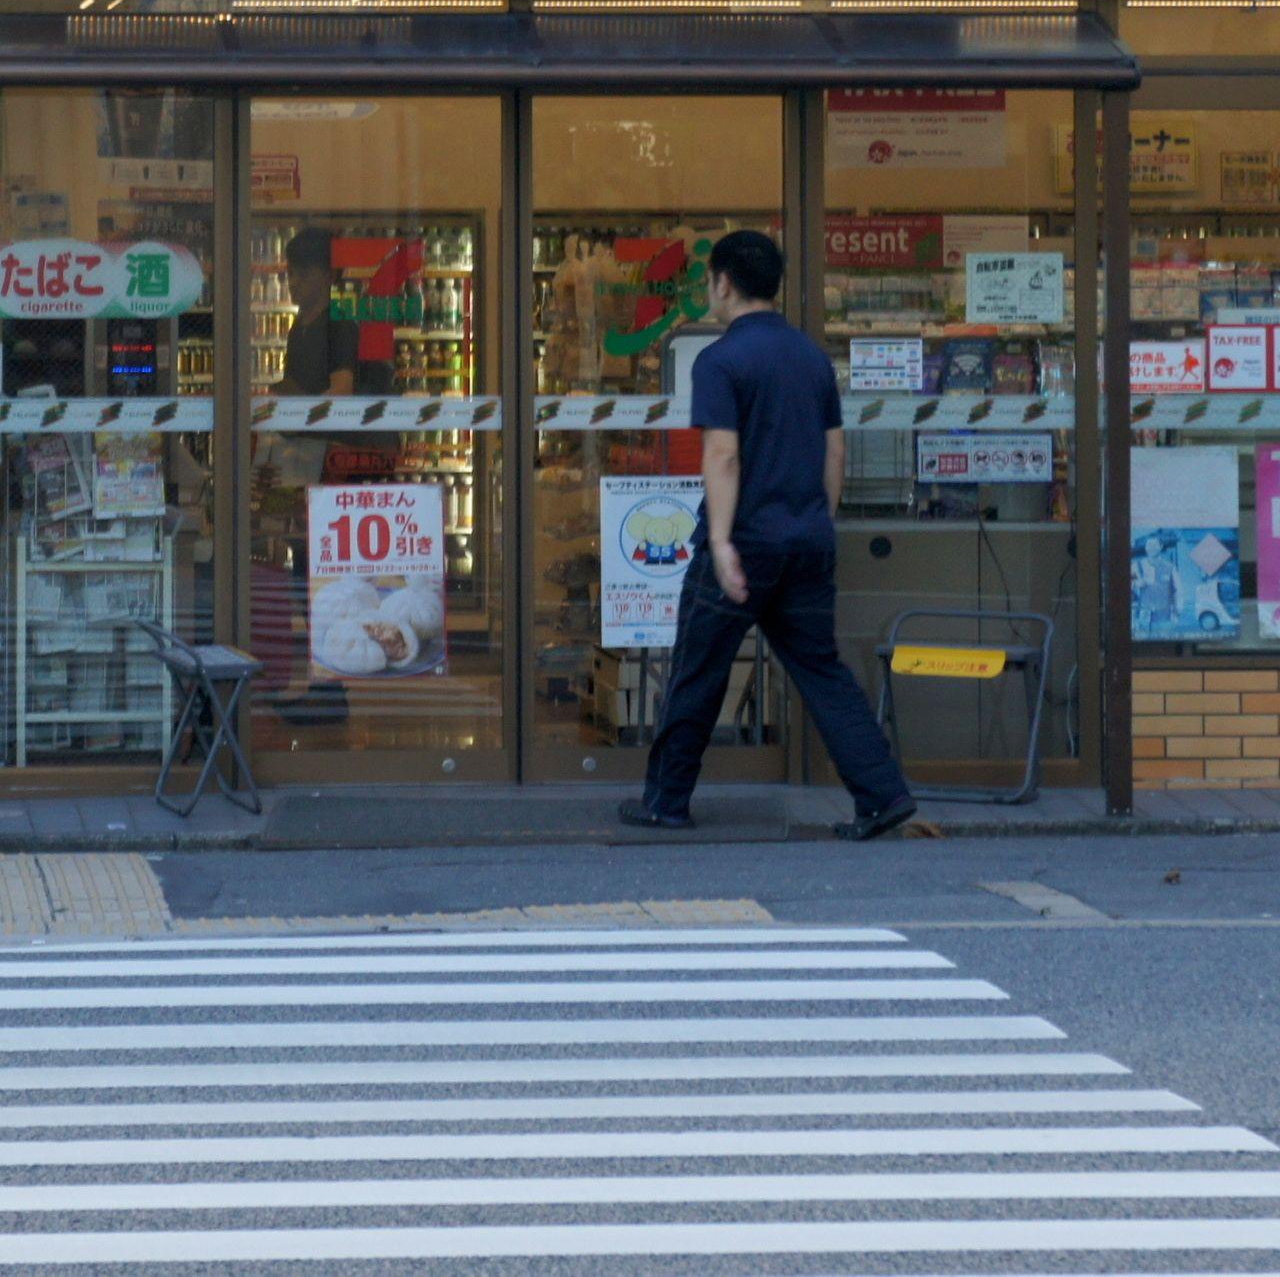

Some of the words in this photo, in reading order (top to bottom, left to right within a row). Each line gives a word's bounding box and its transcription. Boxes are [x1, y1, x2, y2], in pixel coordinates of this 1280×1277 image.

[0, 251, 104, 298] たばこ
[125, 253, 171, 298] 酒
[20, 302, 84, 315] cigarette
[130, 302, 170, 315] liquor
[335, 490, 416, 510] 中華まん
